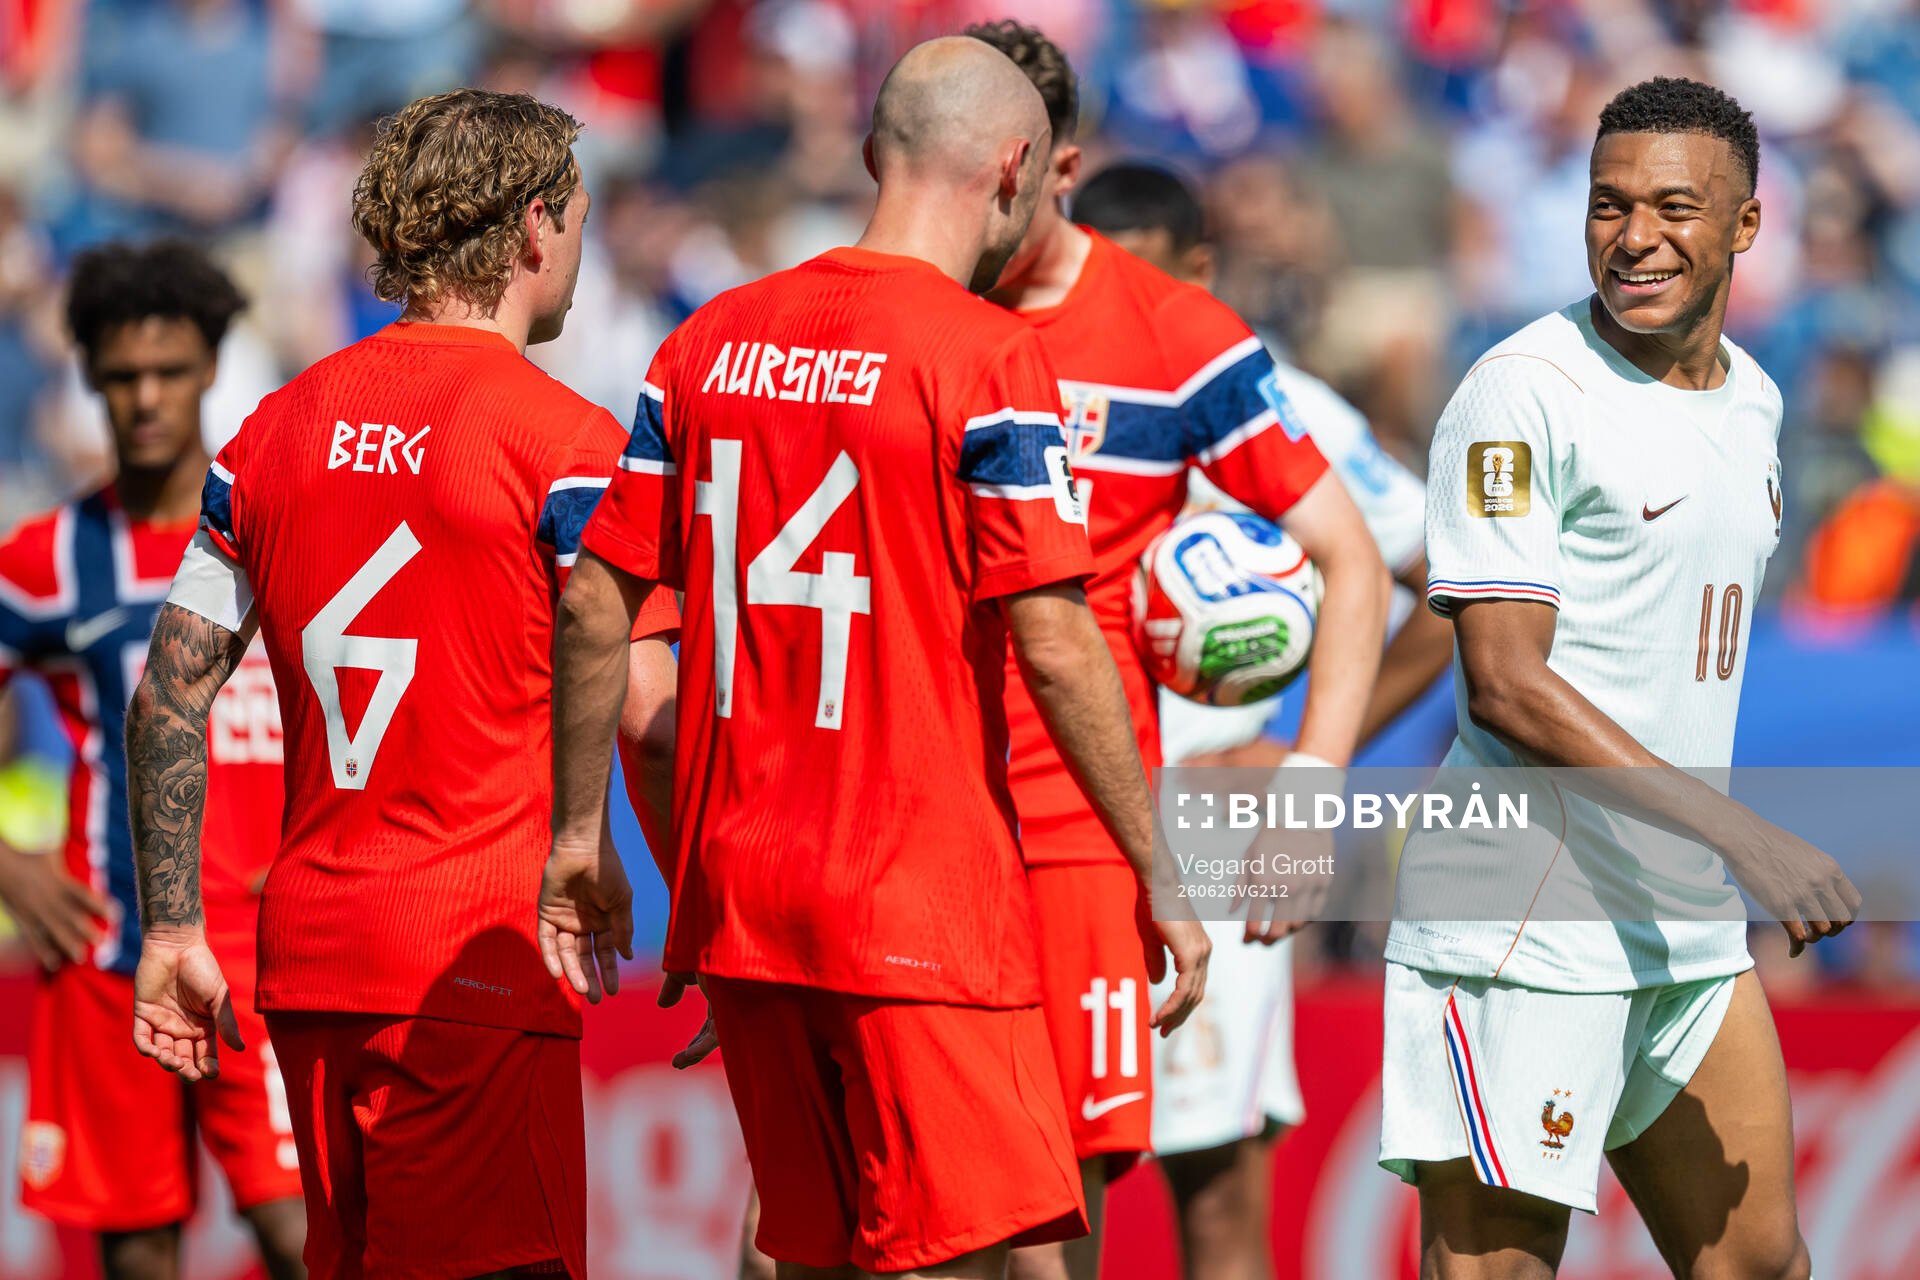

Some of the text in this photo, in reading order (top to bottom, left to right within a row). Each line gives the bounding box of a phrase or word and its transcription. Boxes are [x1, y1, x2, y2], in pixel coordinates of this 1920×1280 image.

[702, 341, 888, 406] AURSNES
[327, 420, 431, 475] BERG
[1484, 503, 1514, 511] 2026
[694, 438, 871, 731] 14
[301, 519, 423, 791] 6
[1695, 583, 1743, 682] 10
[884, 954, 942, 972] AERO-FIT
[1417, 925, 1464, 944] AERO-FIT
[453, 976, 514, 997] AERO-FIT
[1080, 977, 1139, 1079] 11
